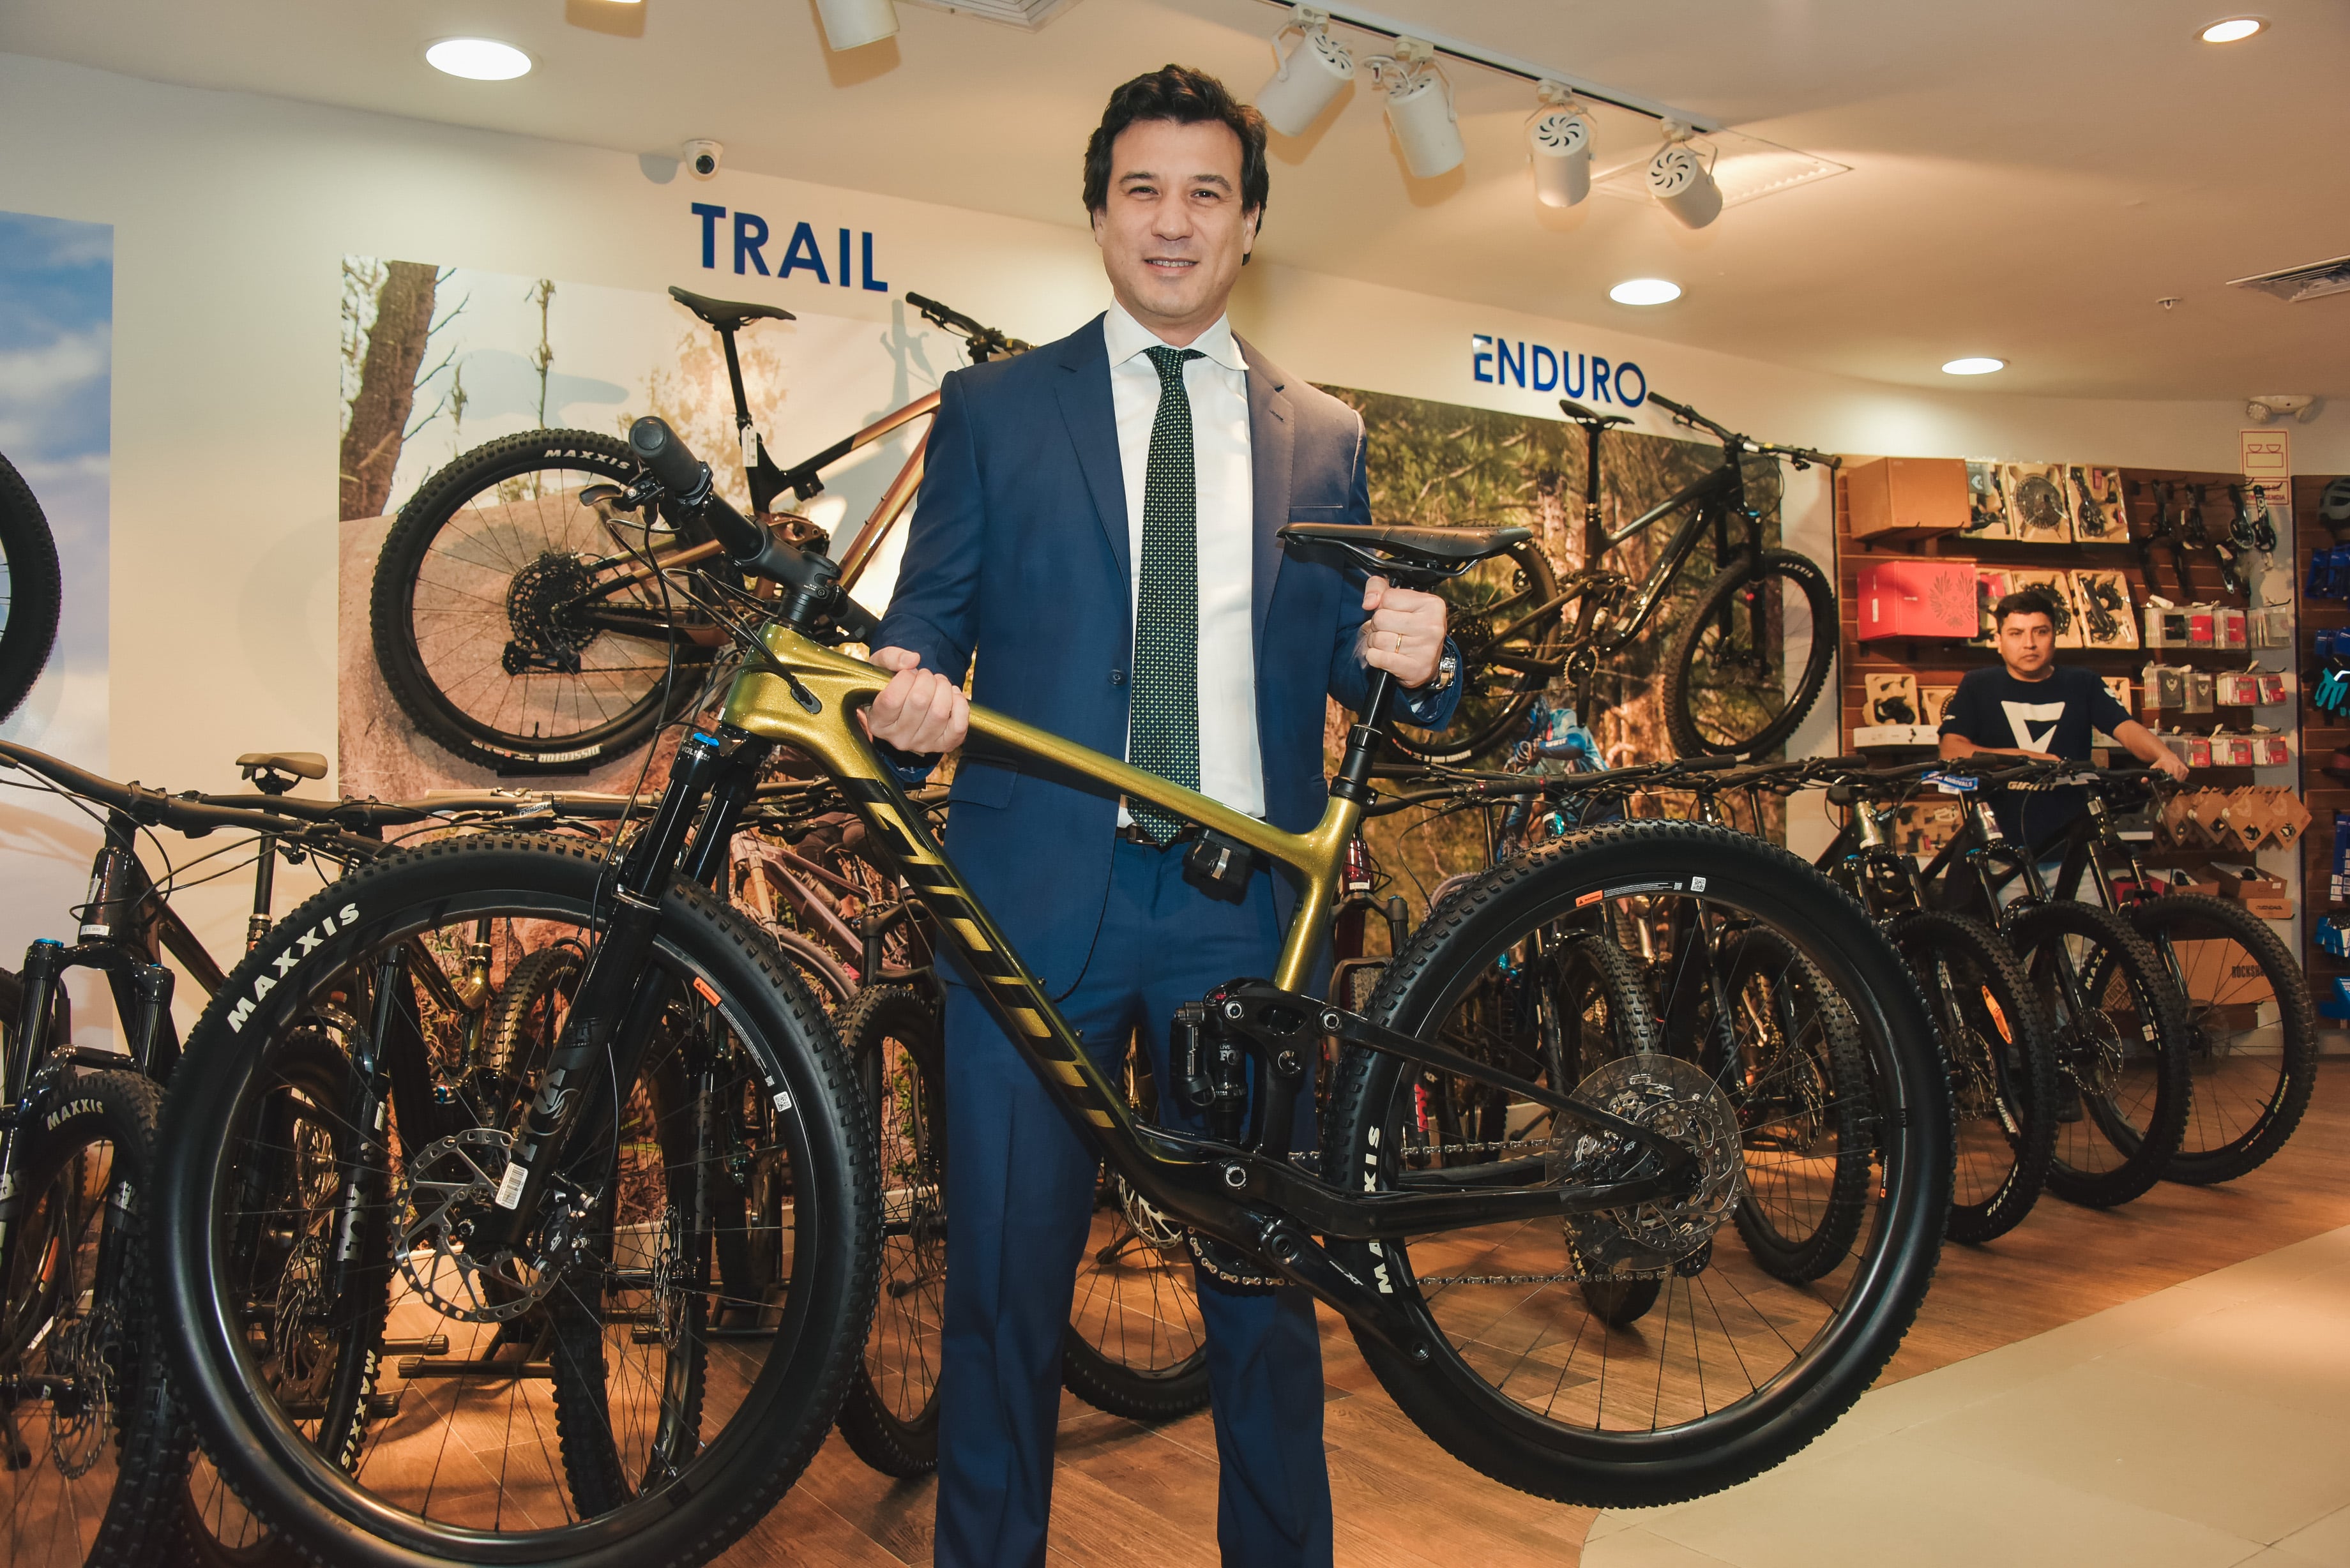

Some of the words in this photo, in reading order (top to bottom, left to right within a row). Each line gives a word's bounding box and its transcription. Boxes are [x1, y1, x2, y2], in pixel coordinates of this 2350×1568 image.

[692, 202, 888, 292] TRAIL
[1473, 335, 1646, 407] ENDURO
[544, 449, 630, 469] MAXXIS
[1778, 562, 1814, 578] MAXXIS
[538, 744, 600, 763] DISSECTOR
[1944, 776, 1973, 787] ARRIVALS
[227, 903, 360, 1033] MAXXIS
[833, 774, 1129, 1129] GIANT
[2084, 947, 2109, 990] MAXX
[2232, 965, 2264, 978] ROCKSH
[47, 1099, 104, 1131] MAXXIS
[1365, 1126, 1393, 1293] MAXIS
[1987, 1163, 2018, 1216] MAXXIS
[337, 1184, 369, 1262] FOX
[341, 1349, 375, 1469] MAXXIS
